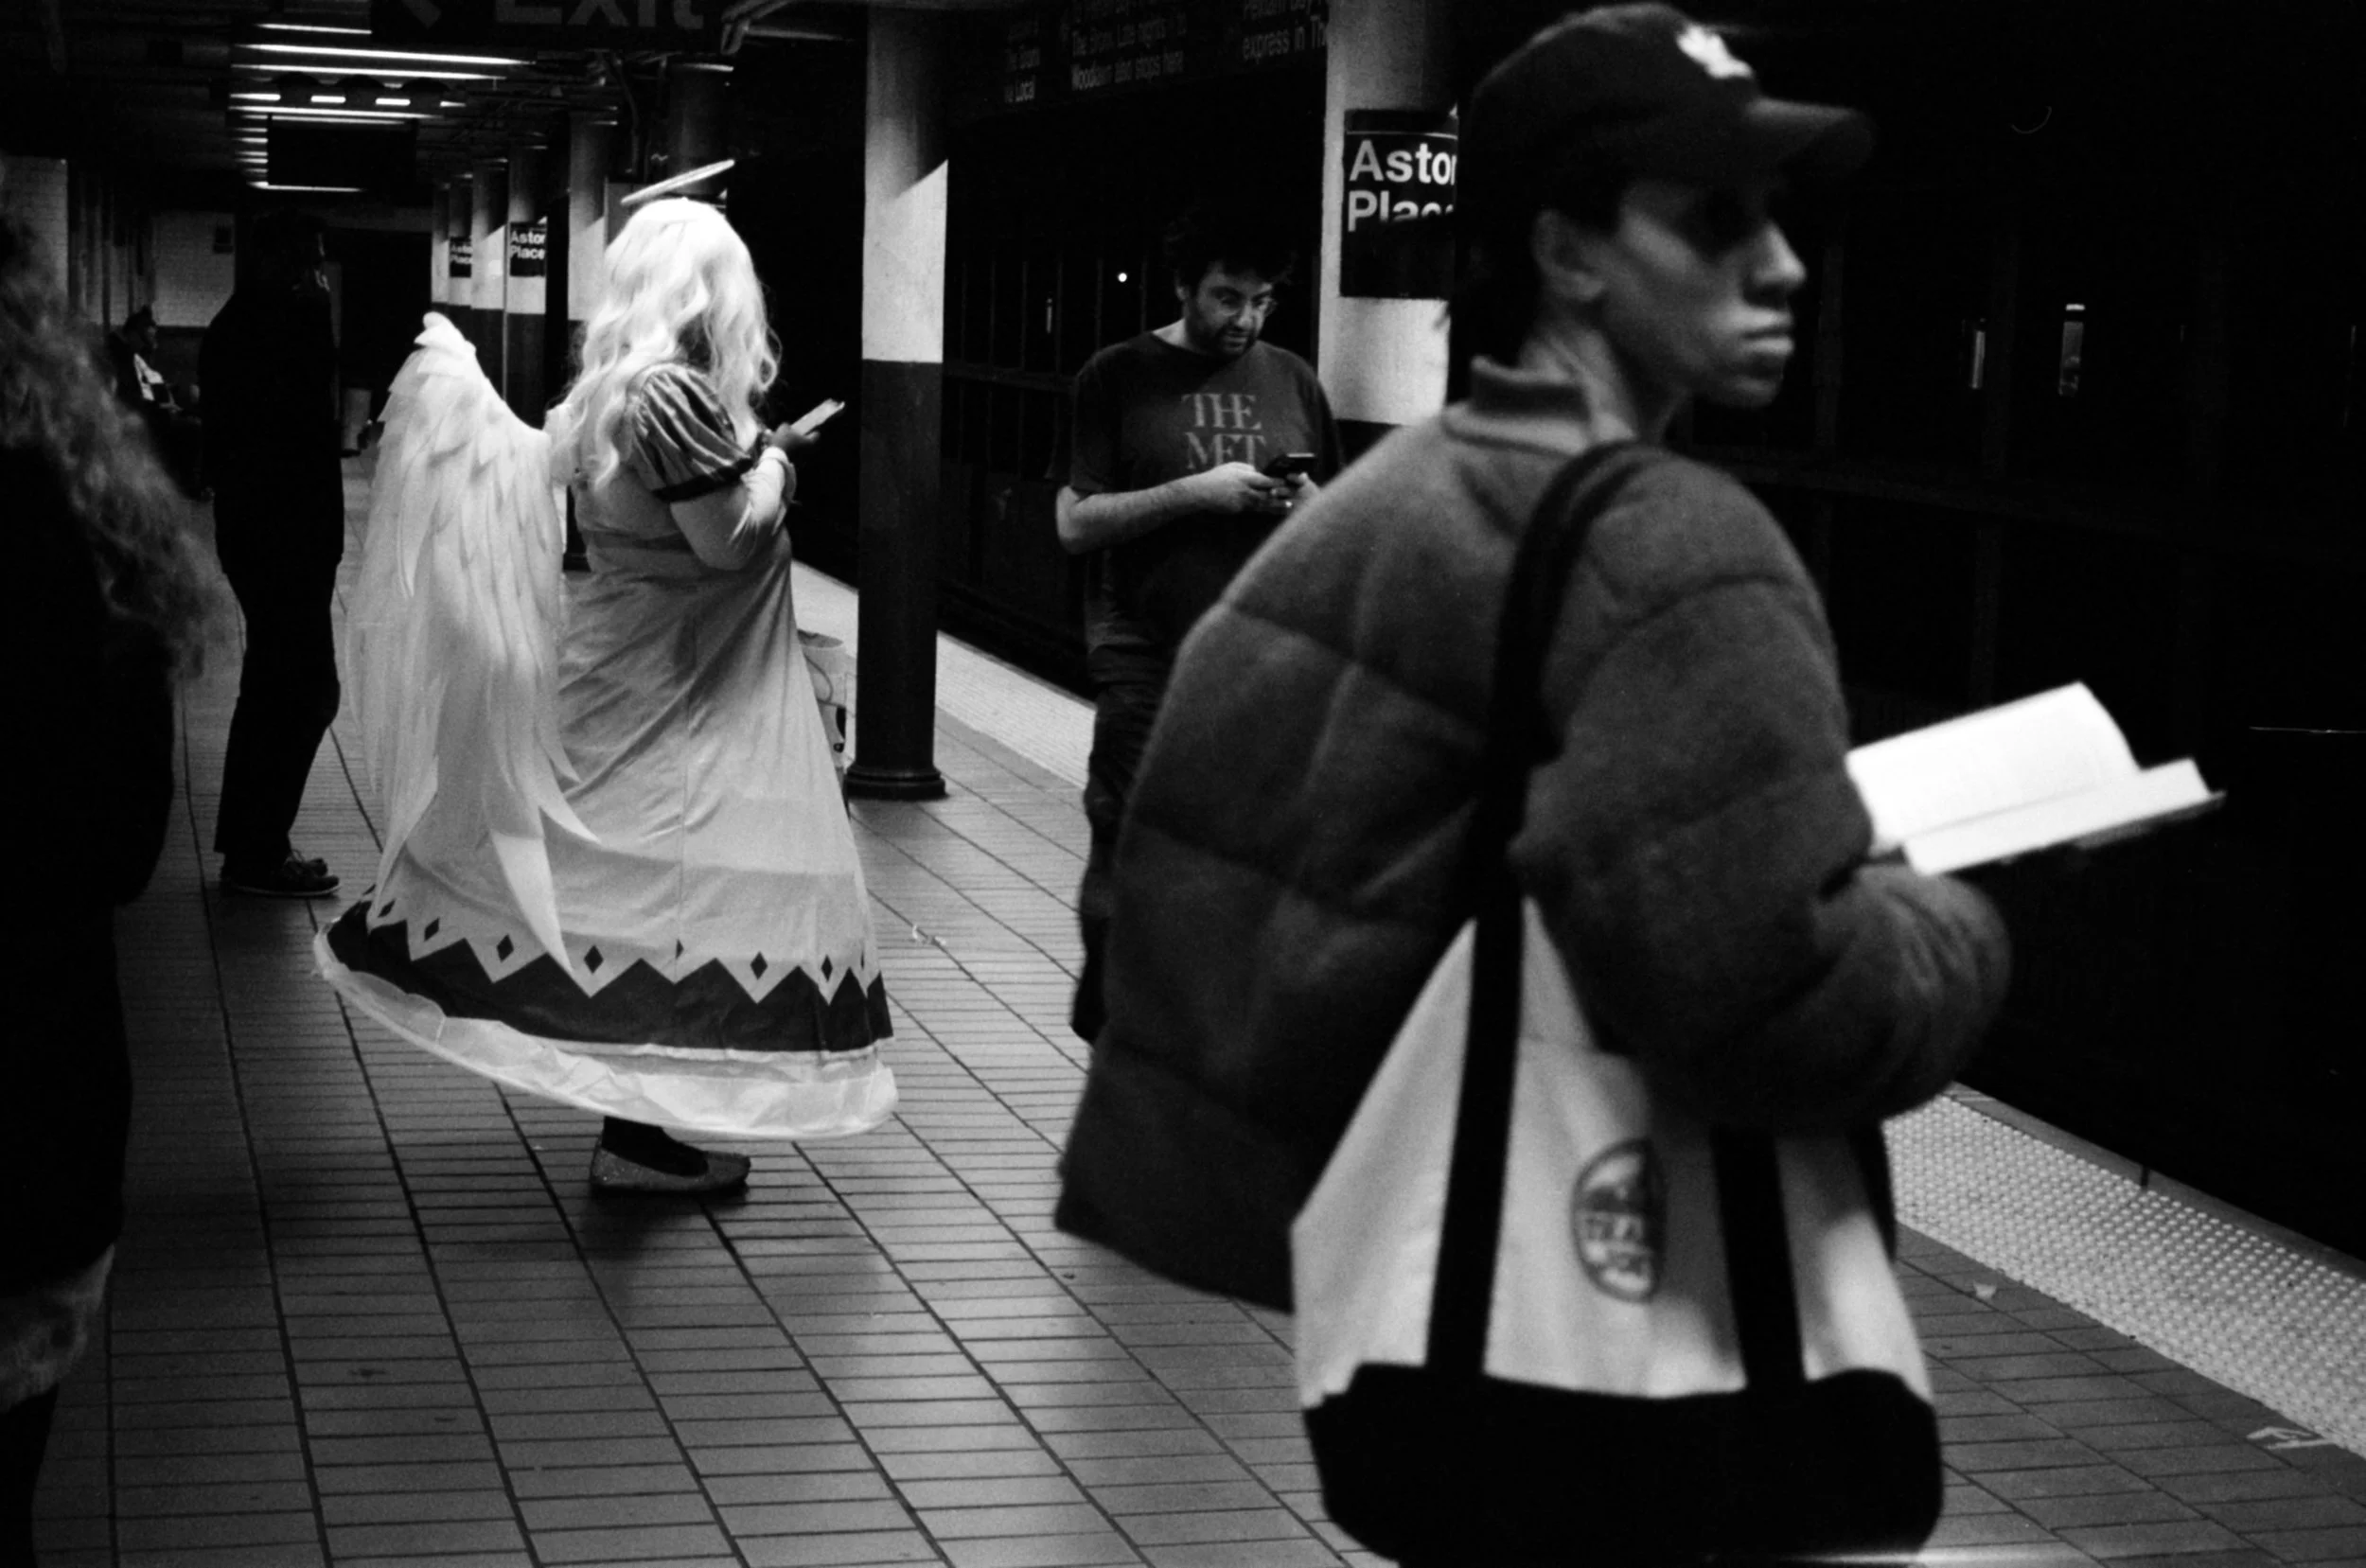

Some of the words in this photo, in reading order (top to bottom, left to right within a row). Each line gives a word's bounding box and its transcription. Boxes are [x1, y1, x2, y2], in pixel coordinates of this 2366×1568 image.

[1242, 29, 1291, 65] express
[1294, 19, 1306, 53] in
[1310, 14, 1327, 50] Th
[1348, 190, 1454, 232] Pla
[450, 243, 474, 254] Asto
[1182, 393, 1262, 430] THE
[1185, 432, 1267, 470] MET
